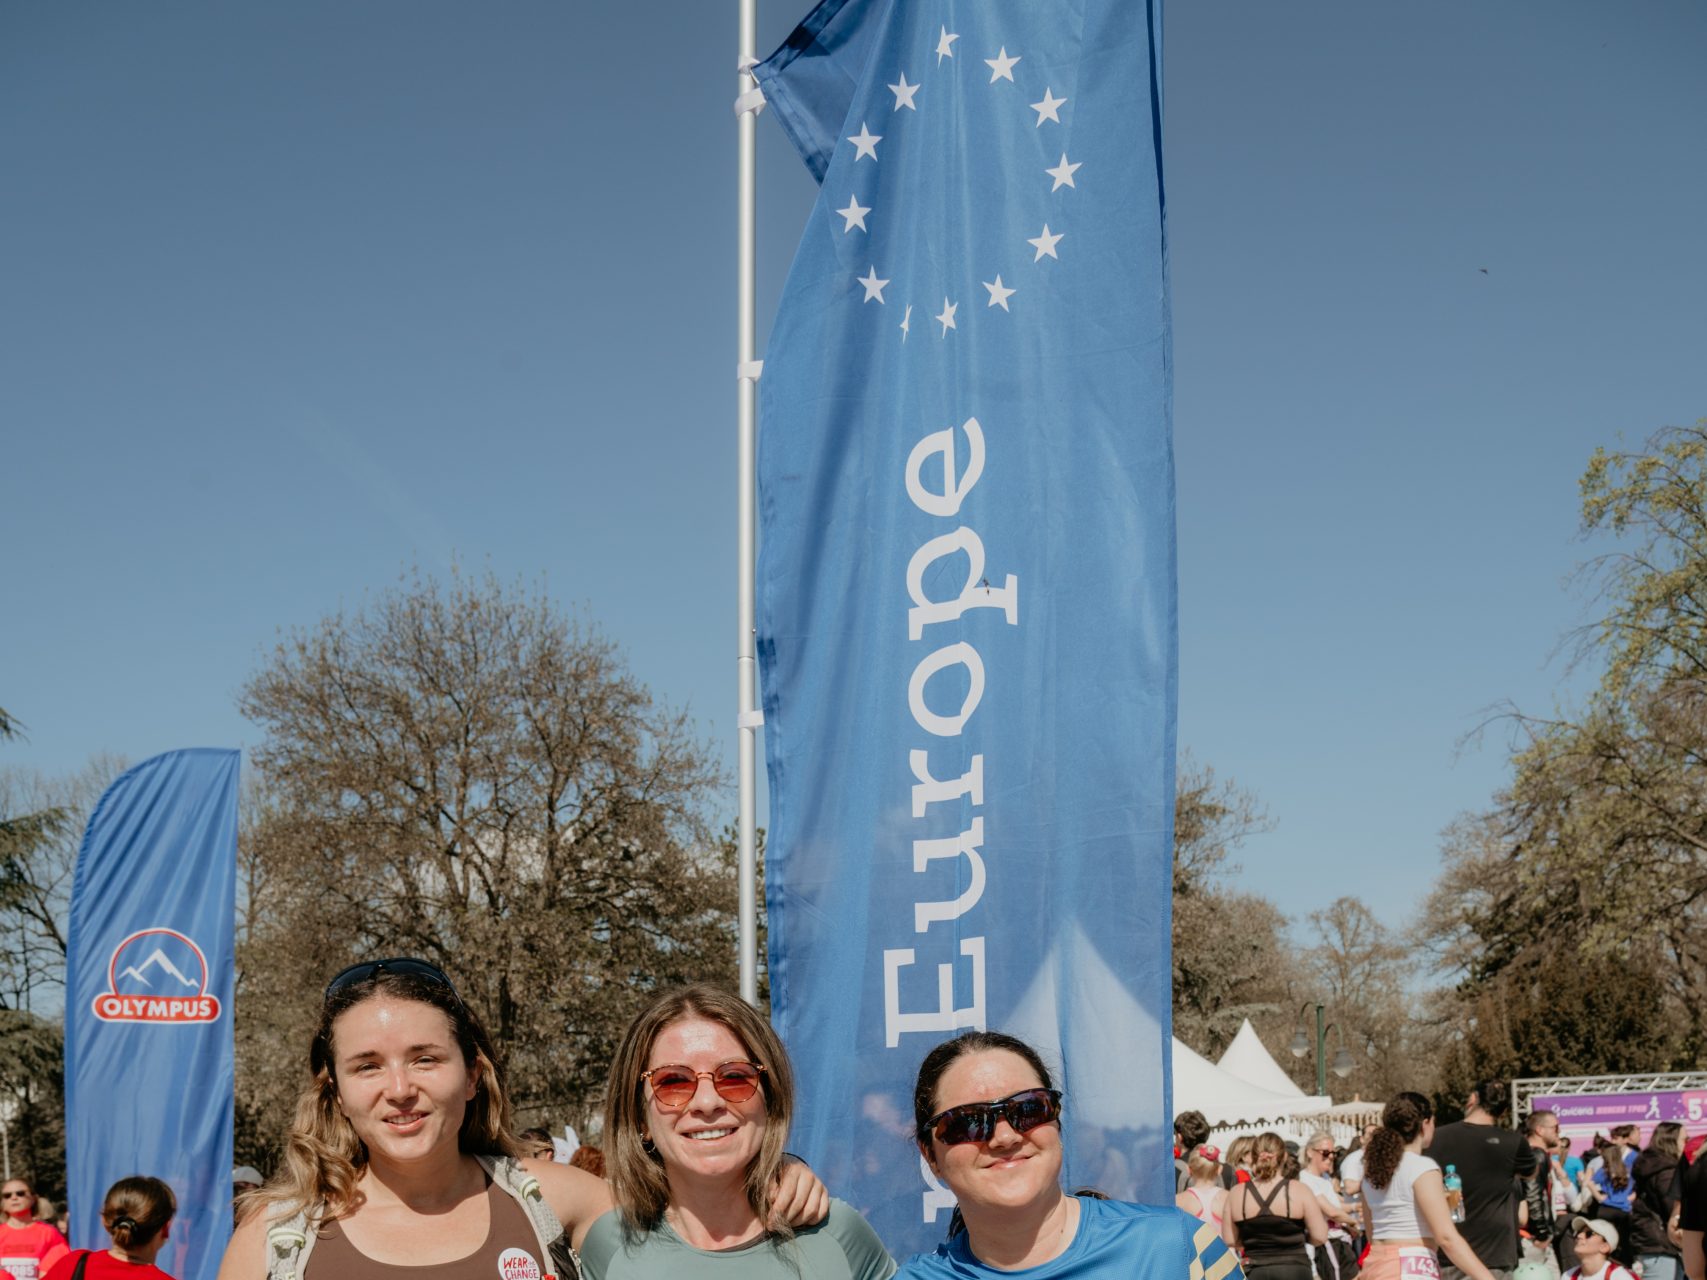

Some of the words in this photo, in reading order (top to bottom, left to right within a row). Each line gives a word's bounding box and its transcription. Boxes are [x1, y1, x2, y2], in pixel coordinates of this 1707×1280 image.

[102, 998, 212, 1018] OLYMPUS
[503, 1256, 528, 1269] WEAR
[505, 1269, 539, 1280] CHANGE
